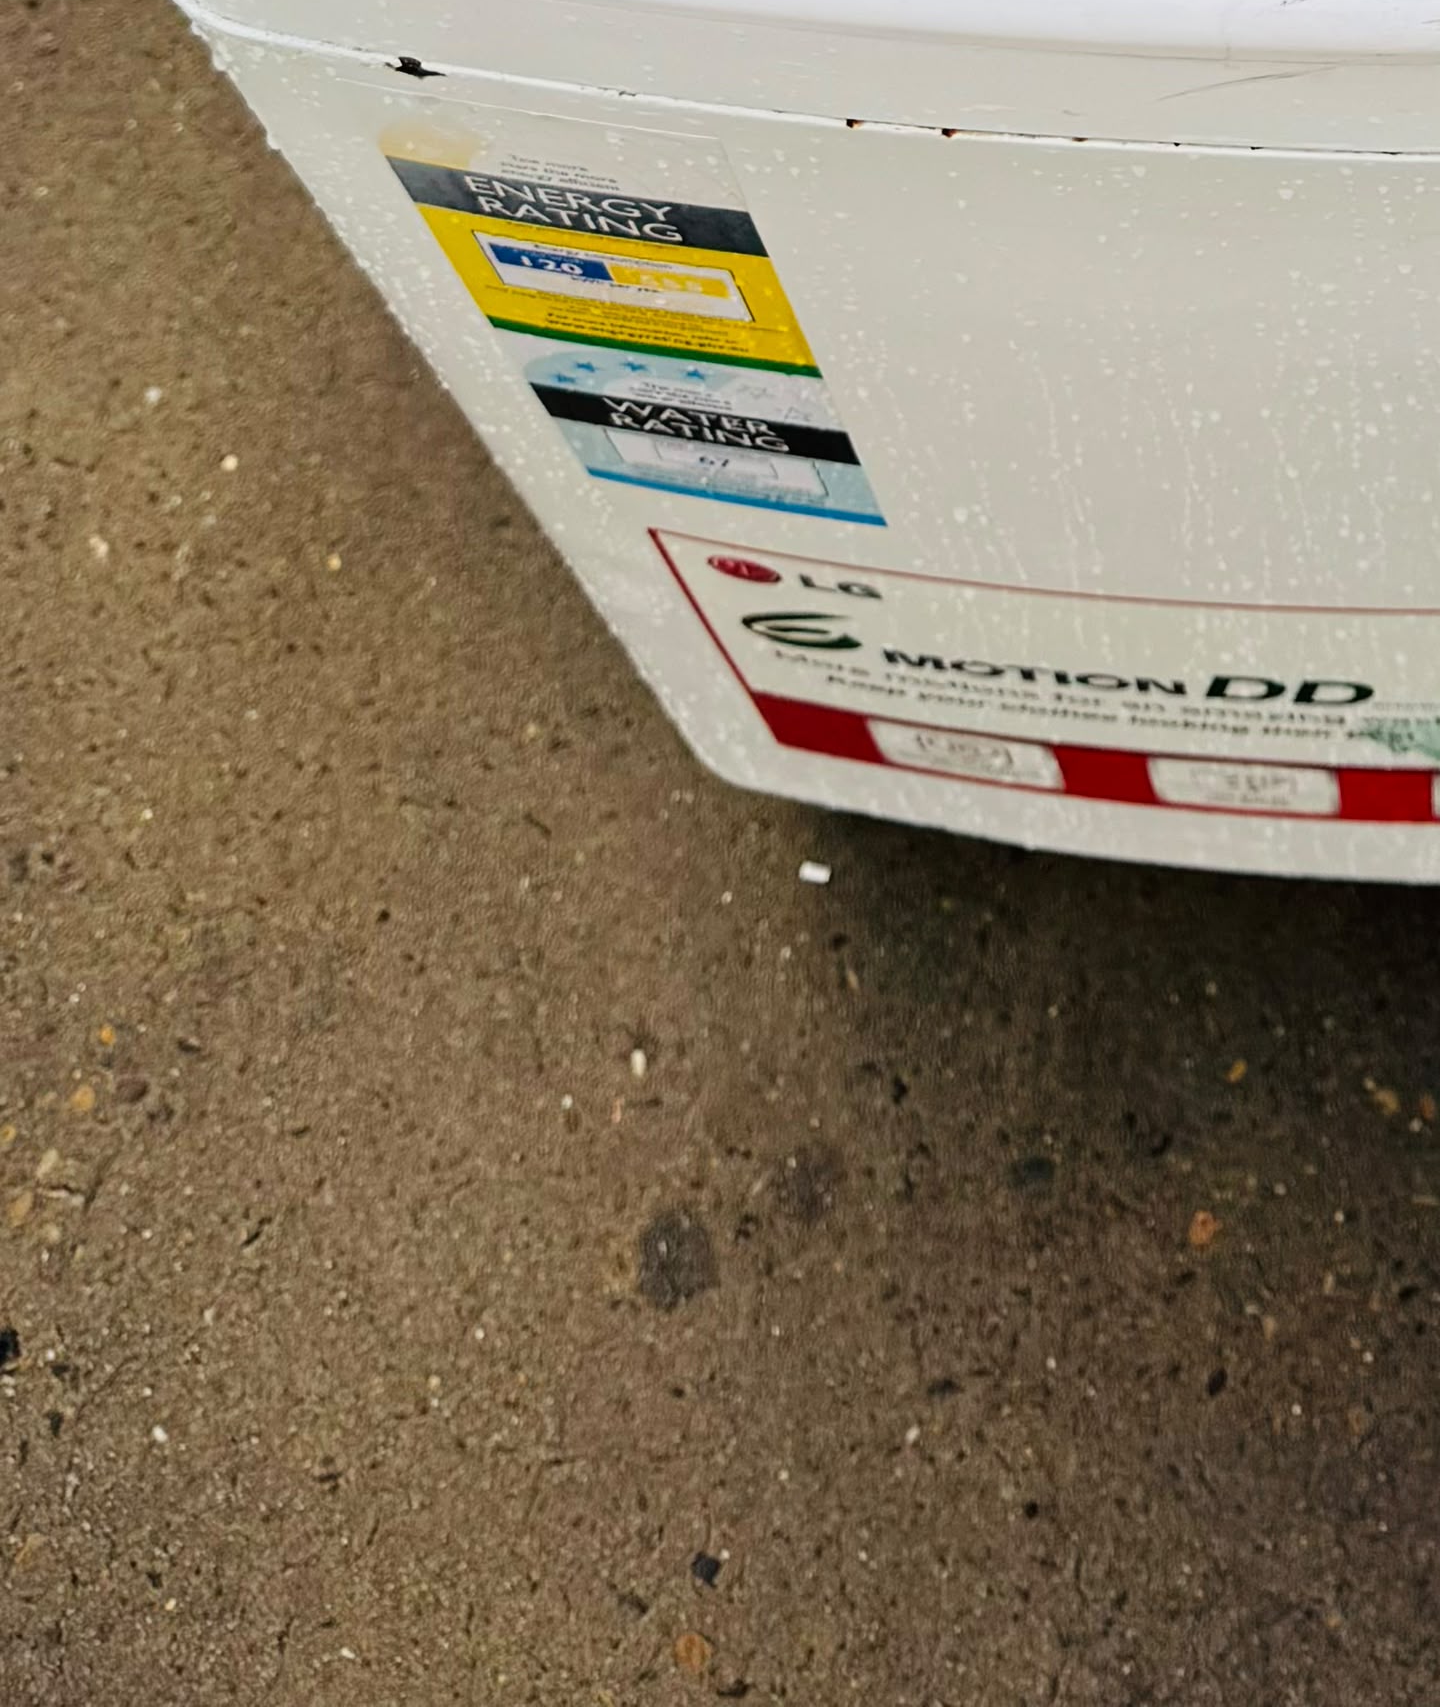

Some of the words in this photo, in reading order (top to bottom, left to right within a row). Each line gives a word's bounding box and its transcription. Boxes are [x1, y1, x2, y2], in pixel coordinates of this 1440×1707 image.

[464, 175, 673, 221] ENERGY
[477, 195, 683, 243] RATING
[602, 396, 777, 436] WATER
[610, 412, 790, 453] RATING
[799, 573, 883, 600] LG
[883, 646, 1188, 696] MOTION
[1205, 674, 1375, 705] DD
